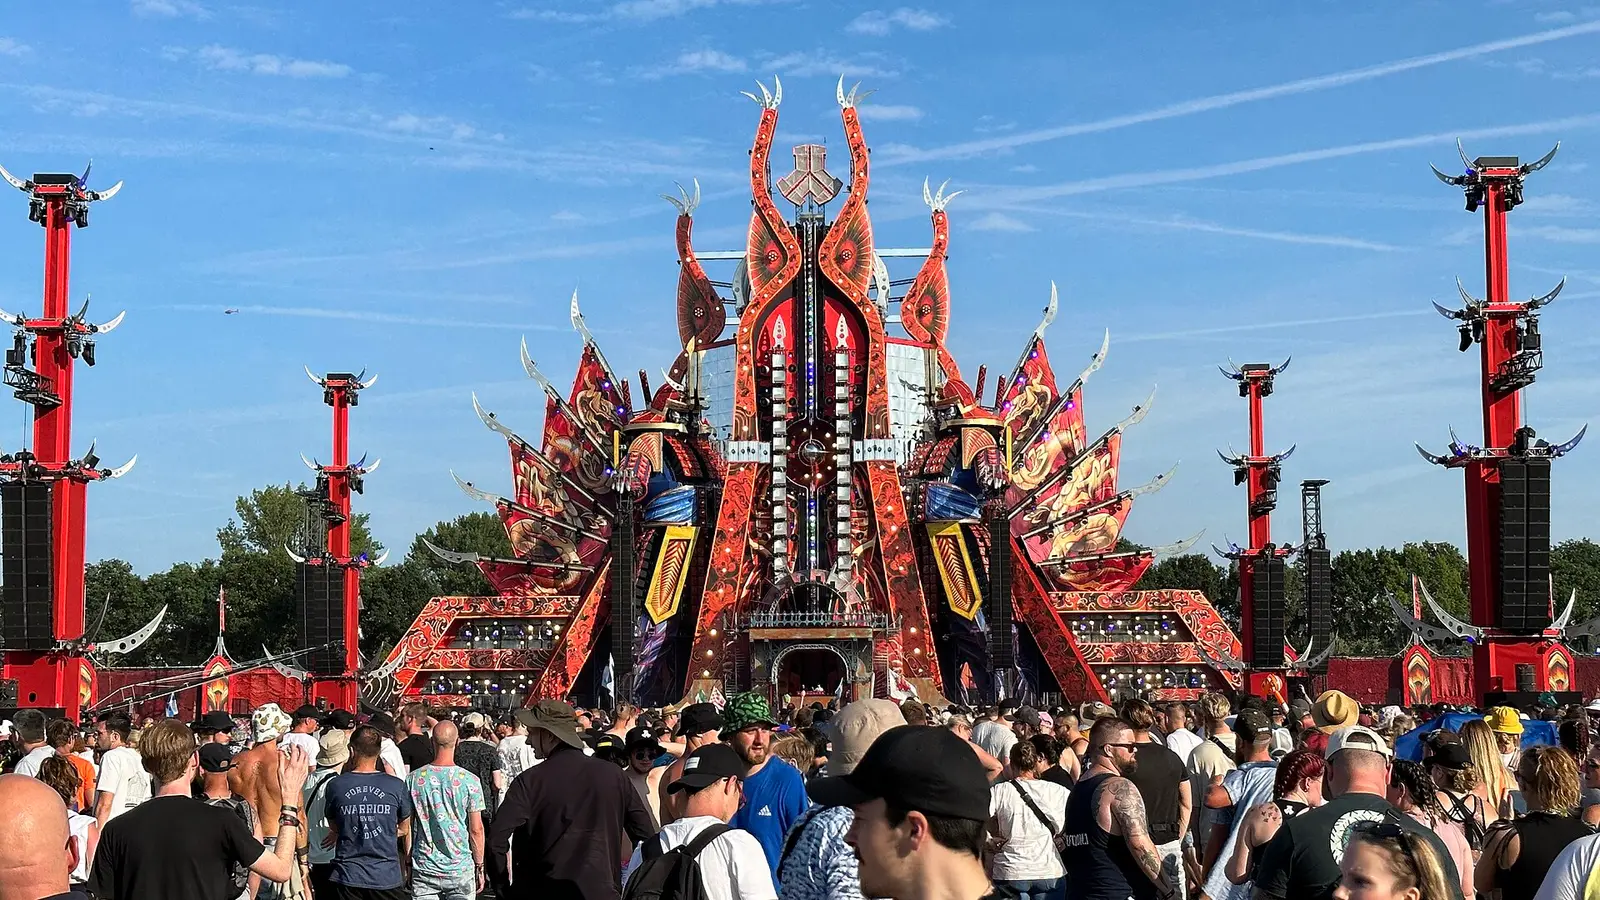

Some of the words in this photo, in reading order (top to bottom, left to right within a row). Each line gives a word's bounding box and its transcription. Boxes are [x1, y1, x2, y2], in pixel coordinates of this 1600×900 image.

[345, 786, 385, 799] FOREVER
[341, 804, 391, 815] WARRIOR
[352, 826, 383, 840] SDIER
